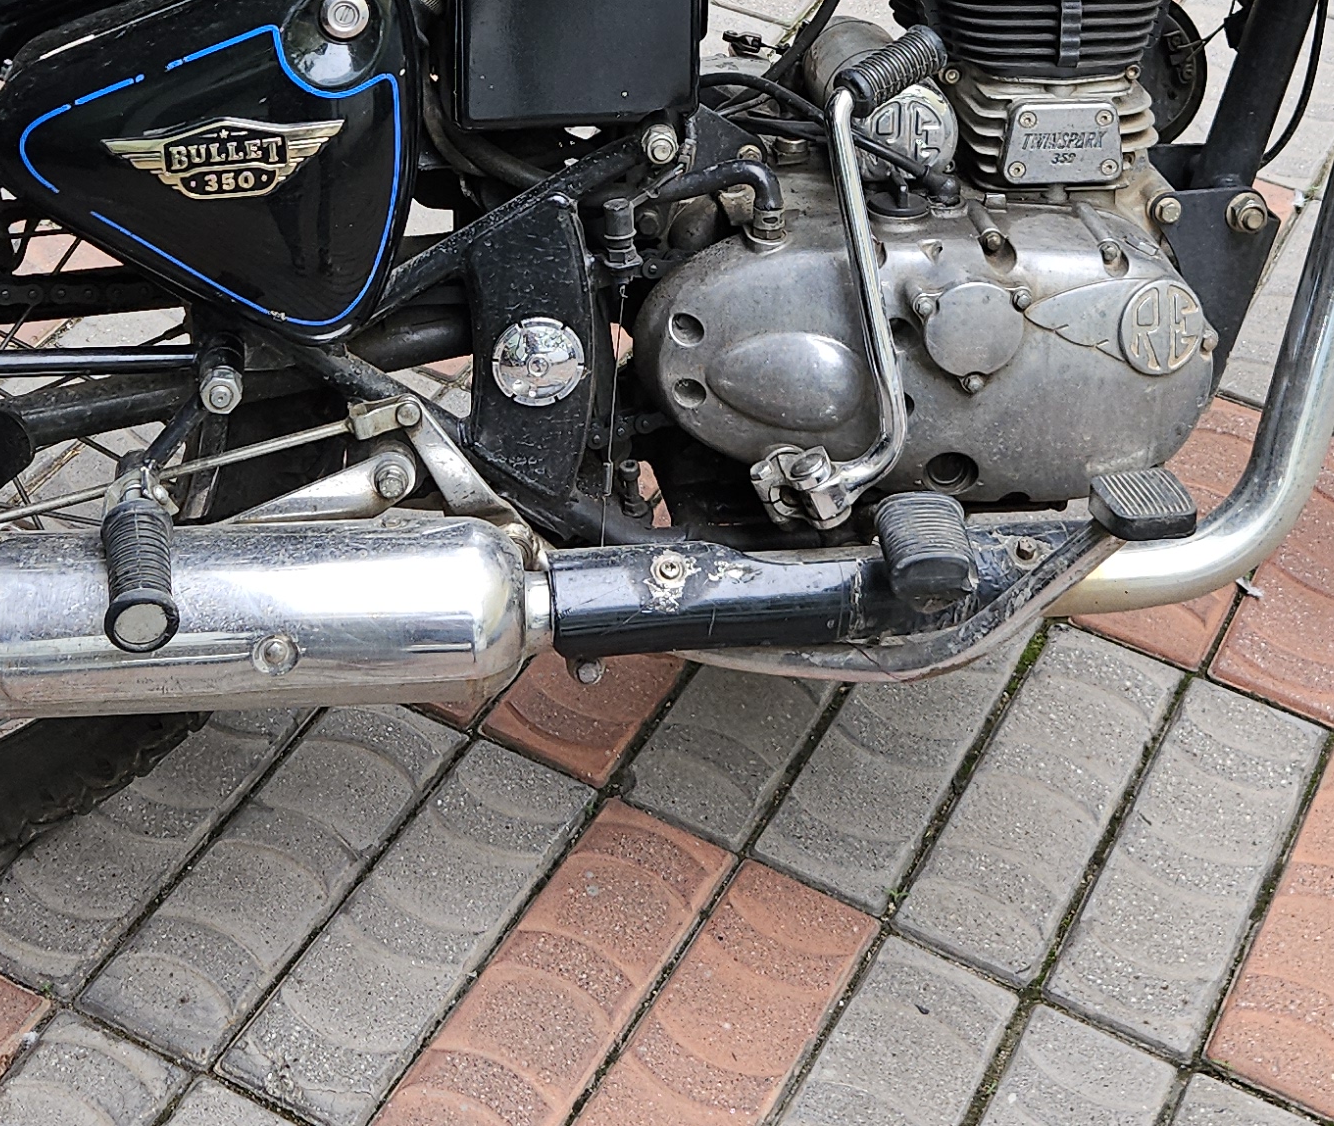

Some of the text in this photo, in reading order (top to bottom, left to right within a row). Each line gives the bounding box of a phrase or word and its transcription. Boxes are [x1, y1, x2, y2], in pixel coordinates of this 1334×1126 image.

[1021, 130, 1107, 151] TWINSPARK
[168, 136, 283, 171] BULLET
[1050, 152, 1077, 165] 350
[203, 170, 256, 193] 350
